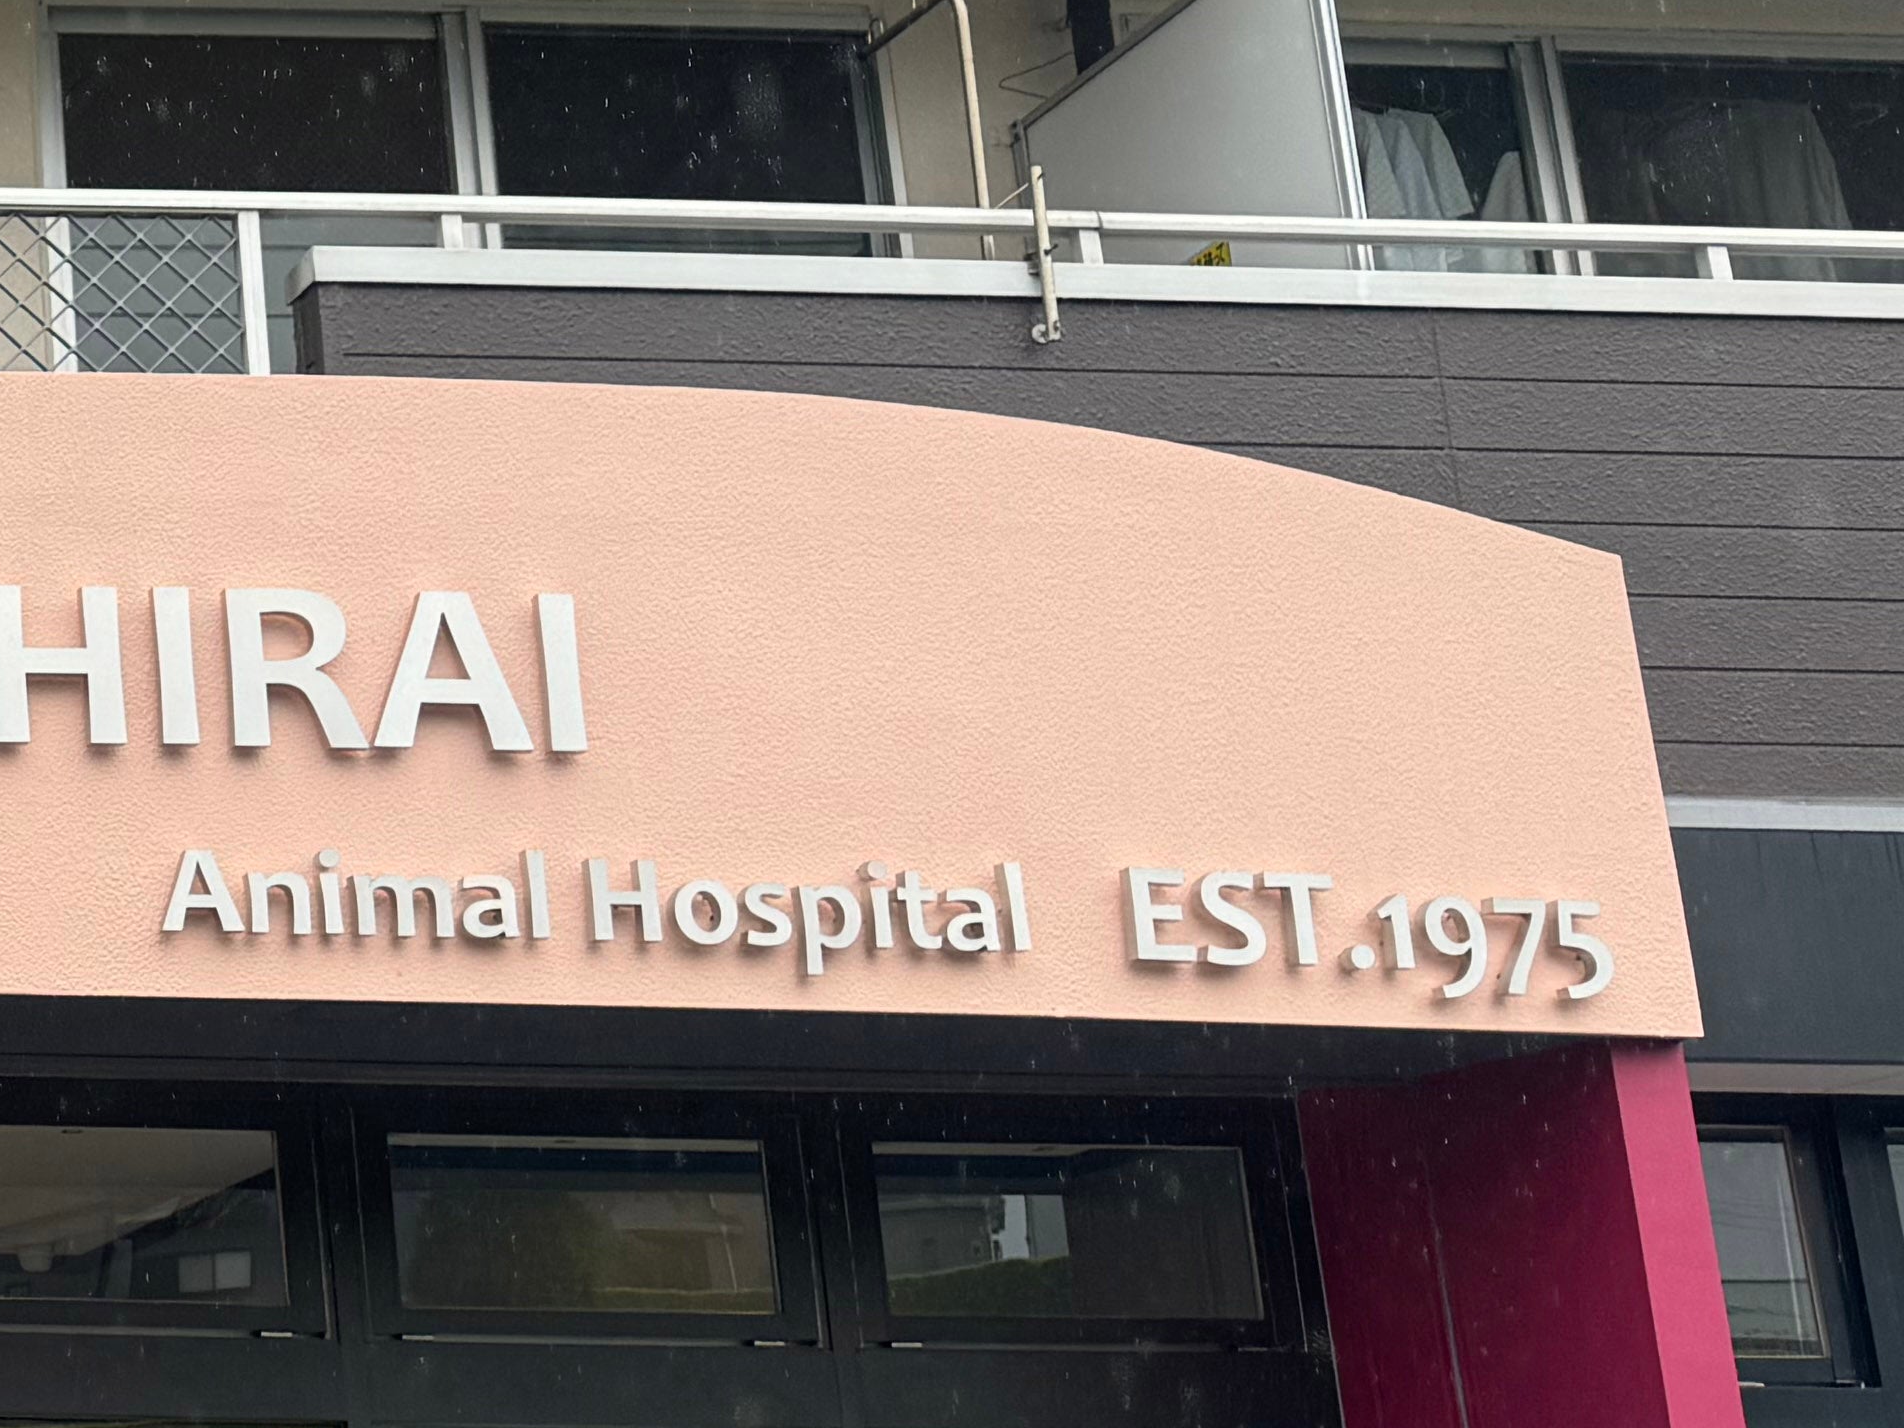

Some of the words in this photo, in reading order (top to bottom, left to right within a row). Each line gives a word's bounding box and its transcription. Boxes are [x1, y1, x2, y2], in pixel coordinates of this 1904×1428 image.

[162, 848, 550, 945] Animal
[583, 856, 1033, 977] Hospital
[1120, 864, 1616, 1002] EST.1975
